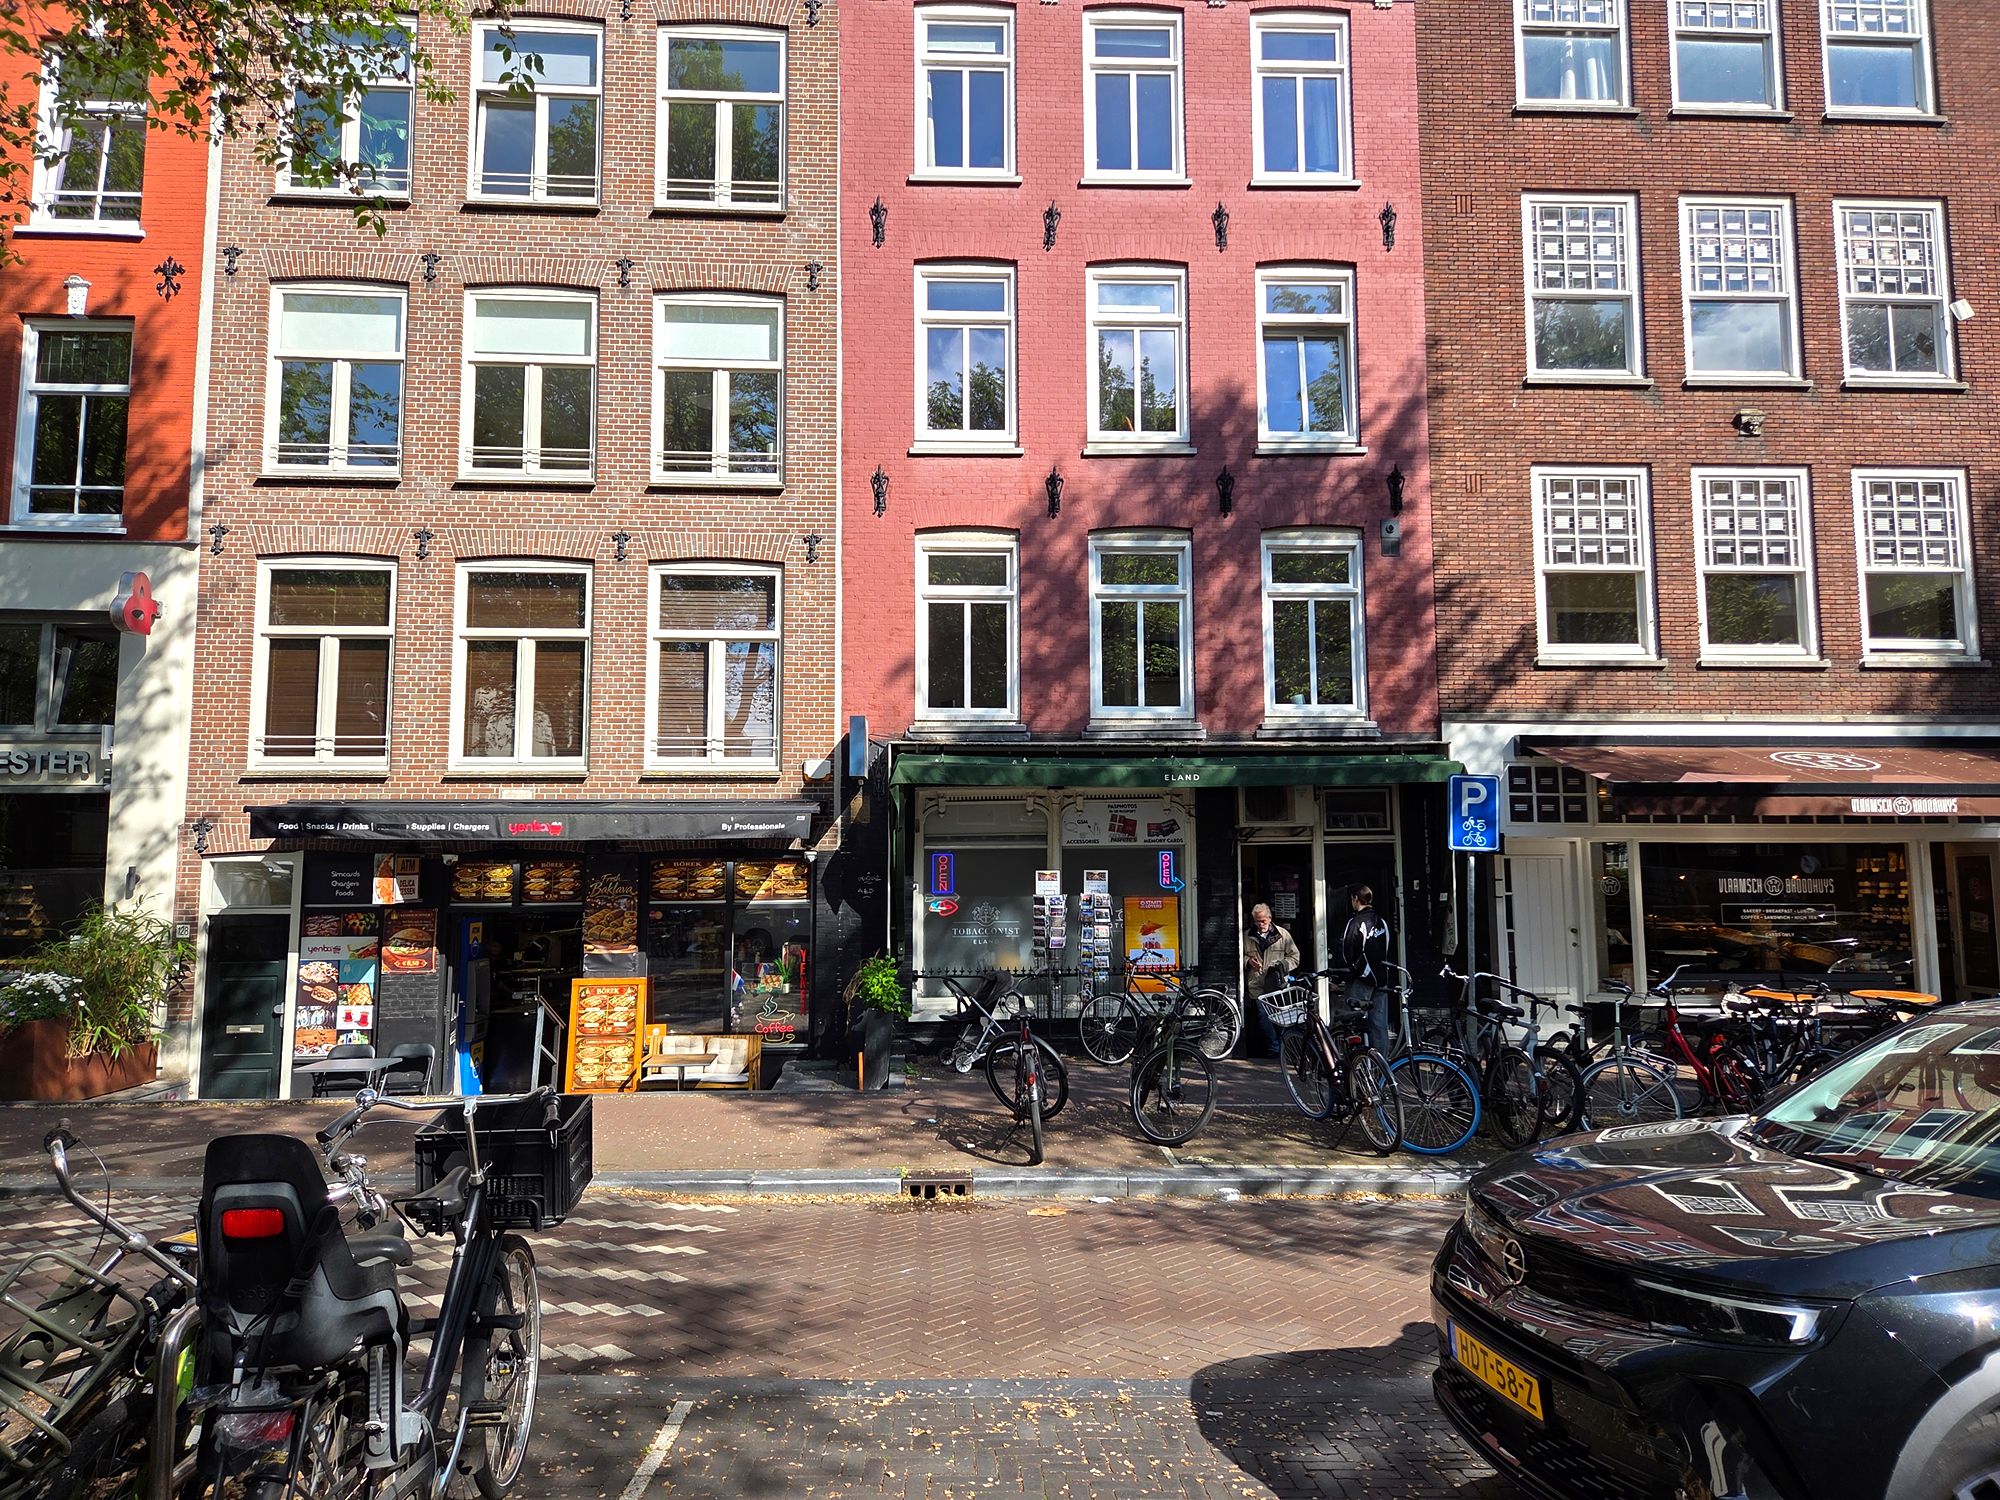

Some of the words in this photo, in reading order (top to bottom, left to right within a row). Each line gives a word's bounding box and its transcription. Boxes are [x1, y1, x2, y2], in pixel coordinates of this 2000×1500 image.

[1462, 782, 1488, 816] P
[1851, 798, 1893, 813] VLAAMSCH
[1911, 798, 1958, 813] BROODHUYS
[278, 822, 299, 830] Food
[305, 822, 335, 831] Snacks
[342, 822, 370, 831] Drinks
[411, 822, 446, 832] Supplies
[453, 822, 490, 832] Chargers
[721, 823, 732, 831] By
[734, 822, 786, 831] Professionals
[400, 859, 416, 872] ATM
[1162, 853, 1170, 885] OPEN
[331, 870, 360, 878] Simcards
[938, 855, 948, 892] OPEN
[331, 880, 359, 889] Chargers
[589, 882, 638, 897] Baklava
[1718, 878, 1763, 893] VLAAMSCH
[1785, 878, 1835, 893] BROODHUYS
[335, 889, 354, 897] Foods
[178, 925, 189, 936] 128
[952, 927, 1020, 935] TOBACCONIST
[755, 1021, 794, 1034] Coffee
[1460, 1333, 1537, 1412] HDT-58-Z
